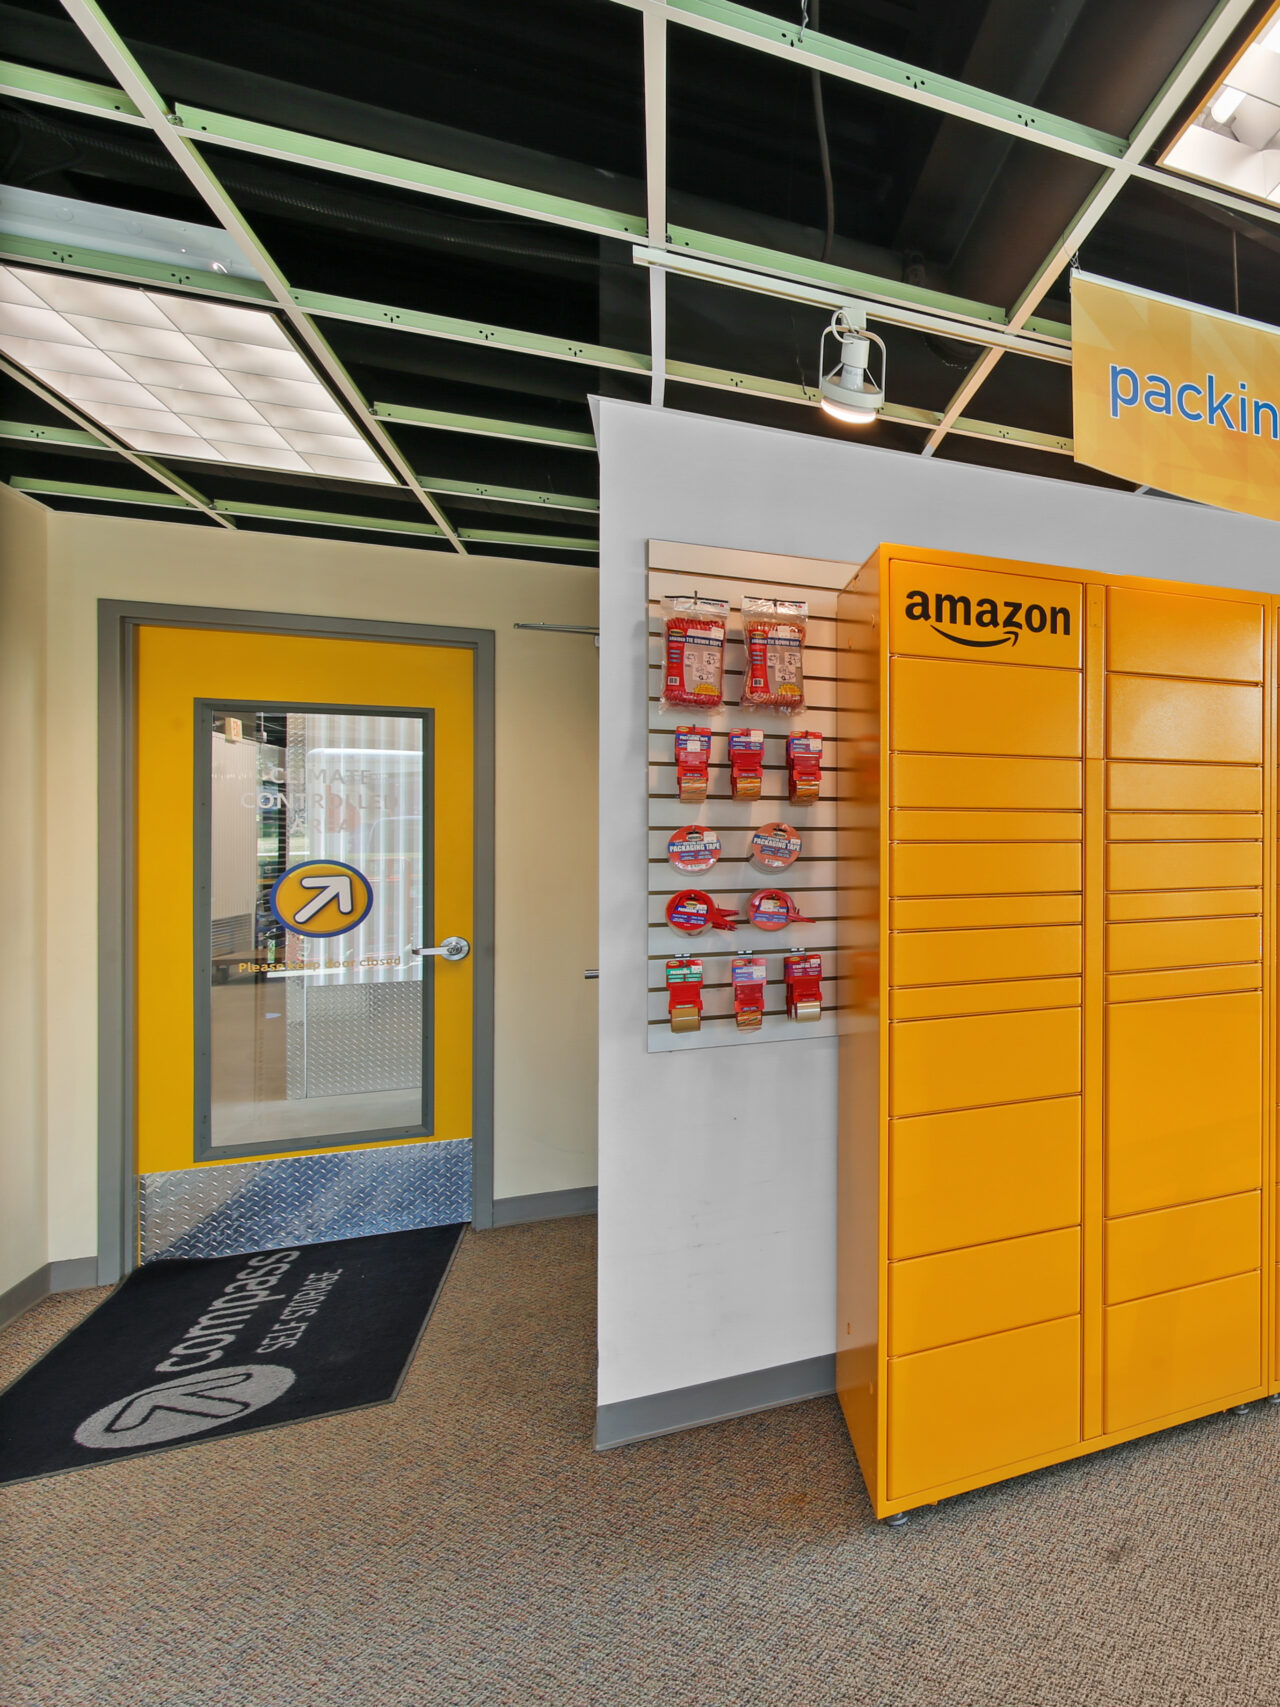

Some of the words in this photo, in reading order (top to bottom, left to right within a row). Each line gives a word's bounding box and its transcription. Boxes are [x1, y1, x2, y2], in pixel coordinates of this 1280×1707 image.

[905, 590, 1071, 636] amazon
[271, 767, 371, 785] CLIMATE
[241, 792, 399, 810] CONTROLLED
[706, 842, 721, 850] TAPE
[753, 838, 787, 848] PACKAGING
[787, 843, 801, 851] TAPE
[238, 962, 285, 973] Please
[287, 960, 321, 972] keep
[326, 958, 355, 969] door
[359, 955, 401, 967] closed
[279, 1268, 344, 1320] STORAGE
[155, 1250, 300, 1372] compass
[256, 1321, 310, 1354] SELF
